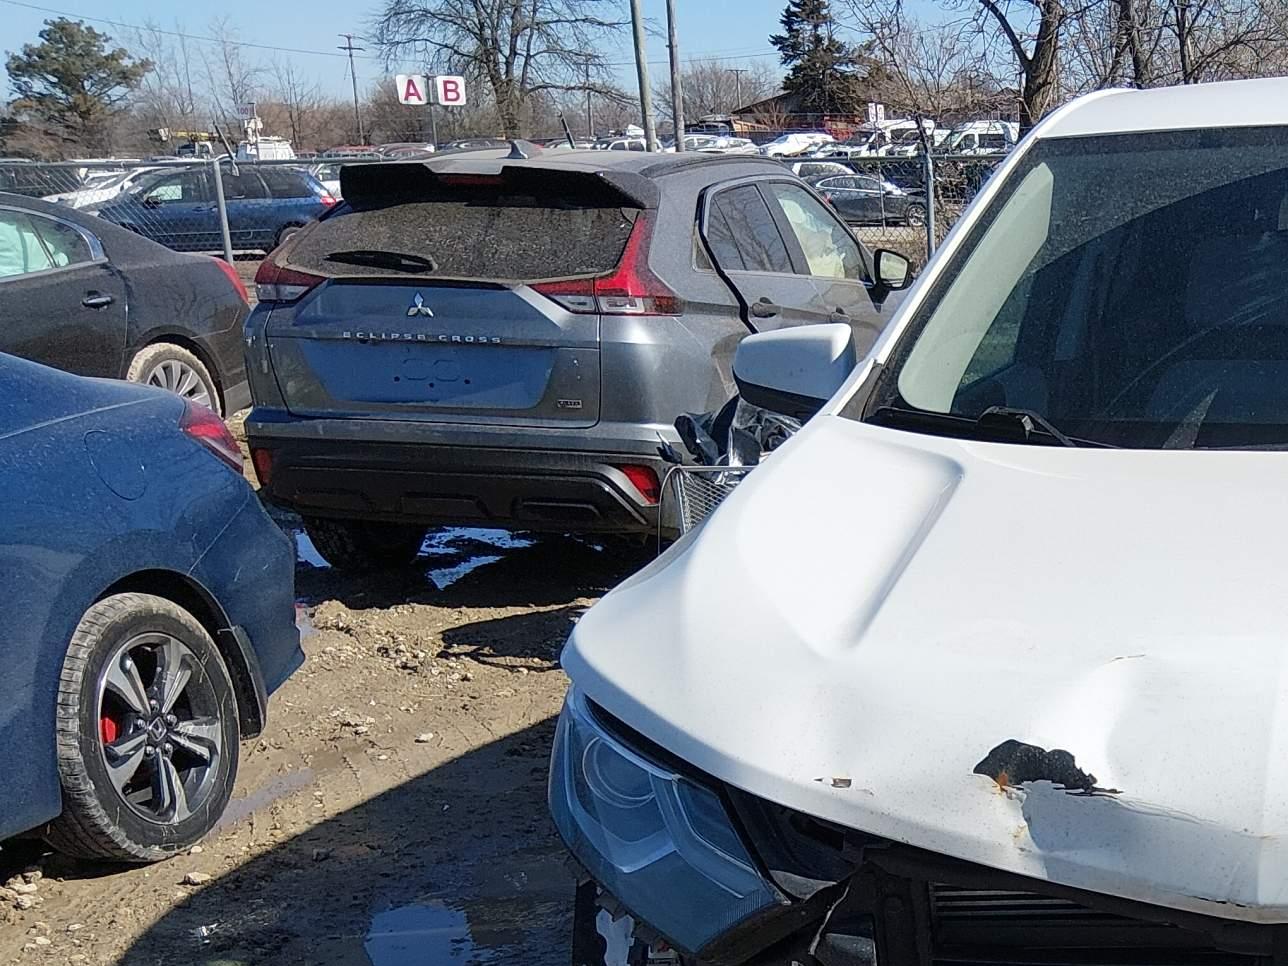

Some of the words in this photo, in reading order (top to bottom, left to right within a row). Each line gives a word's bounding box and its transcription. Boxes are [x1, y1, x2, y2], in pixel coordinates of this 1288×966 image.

[404, 79, 423, 101] A
[443, 80, 461, 101] B
[343, 331, 426, 340] ECLIPSE
[439, 335, 501, 343] CROSS
